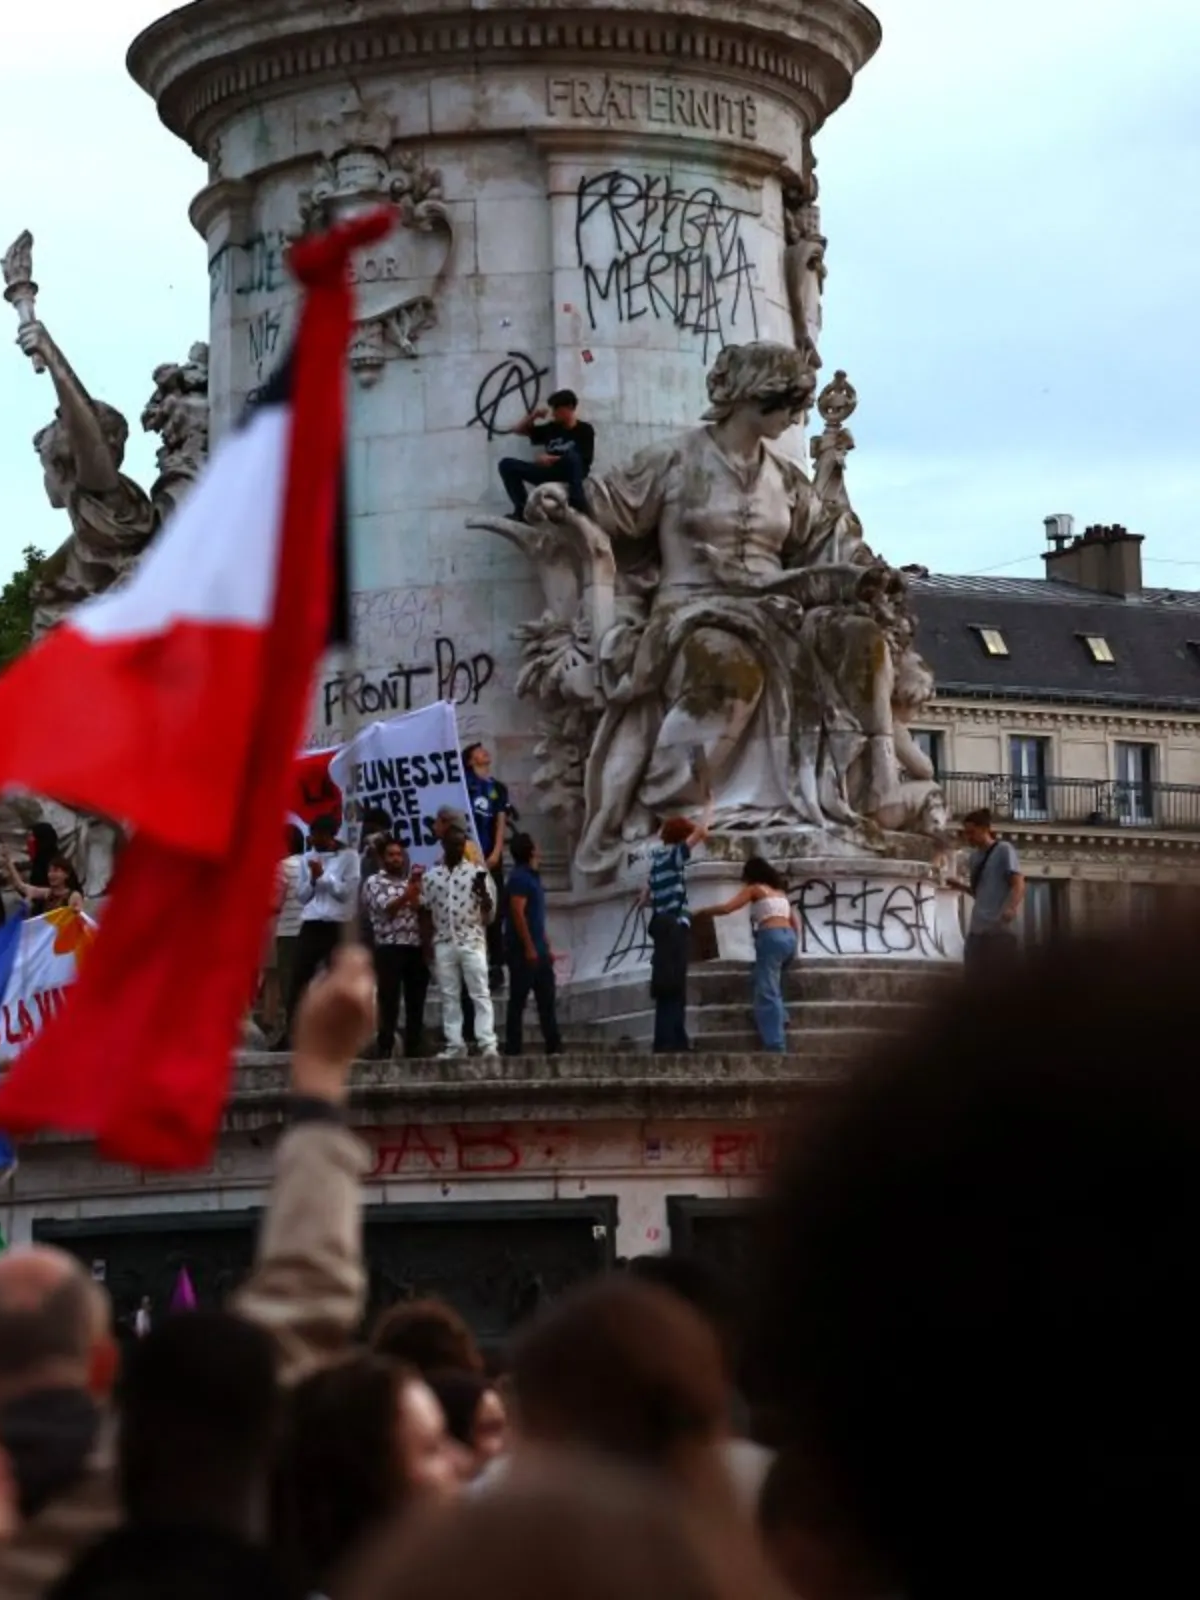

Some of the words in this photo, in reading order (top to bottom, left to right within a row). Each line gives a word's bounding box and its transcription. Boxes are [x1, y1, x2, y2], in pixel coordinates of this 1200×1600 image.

[545, 75, 758, 140] FRATERNITÉ
[324, 663, 432, 726] FRONT
[435, 637, 495, 706] POP
